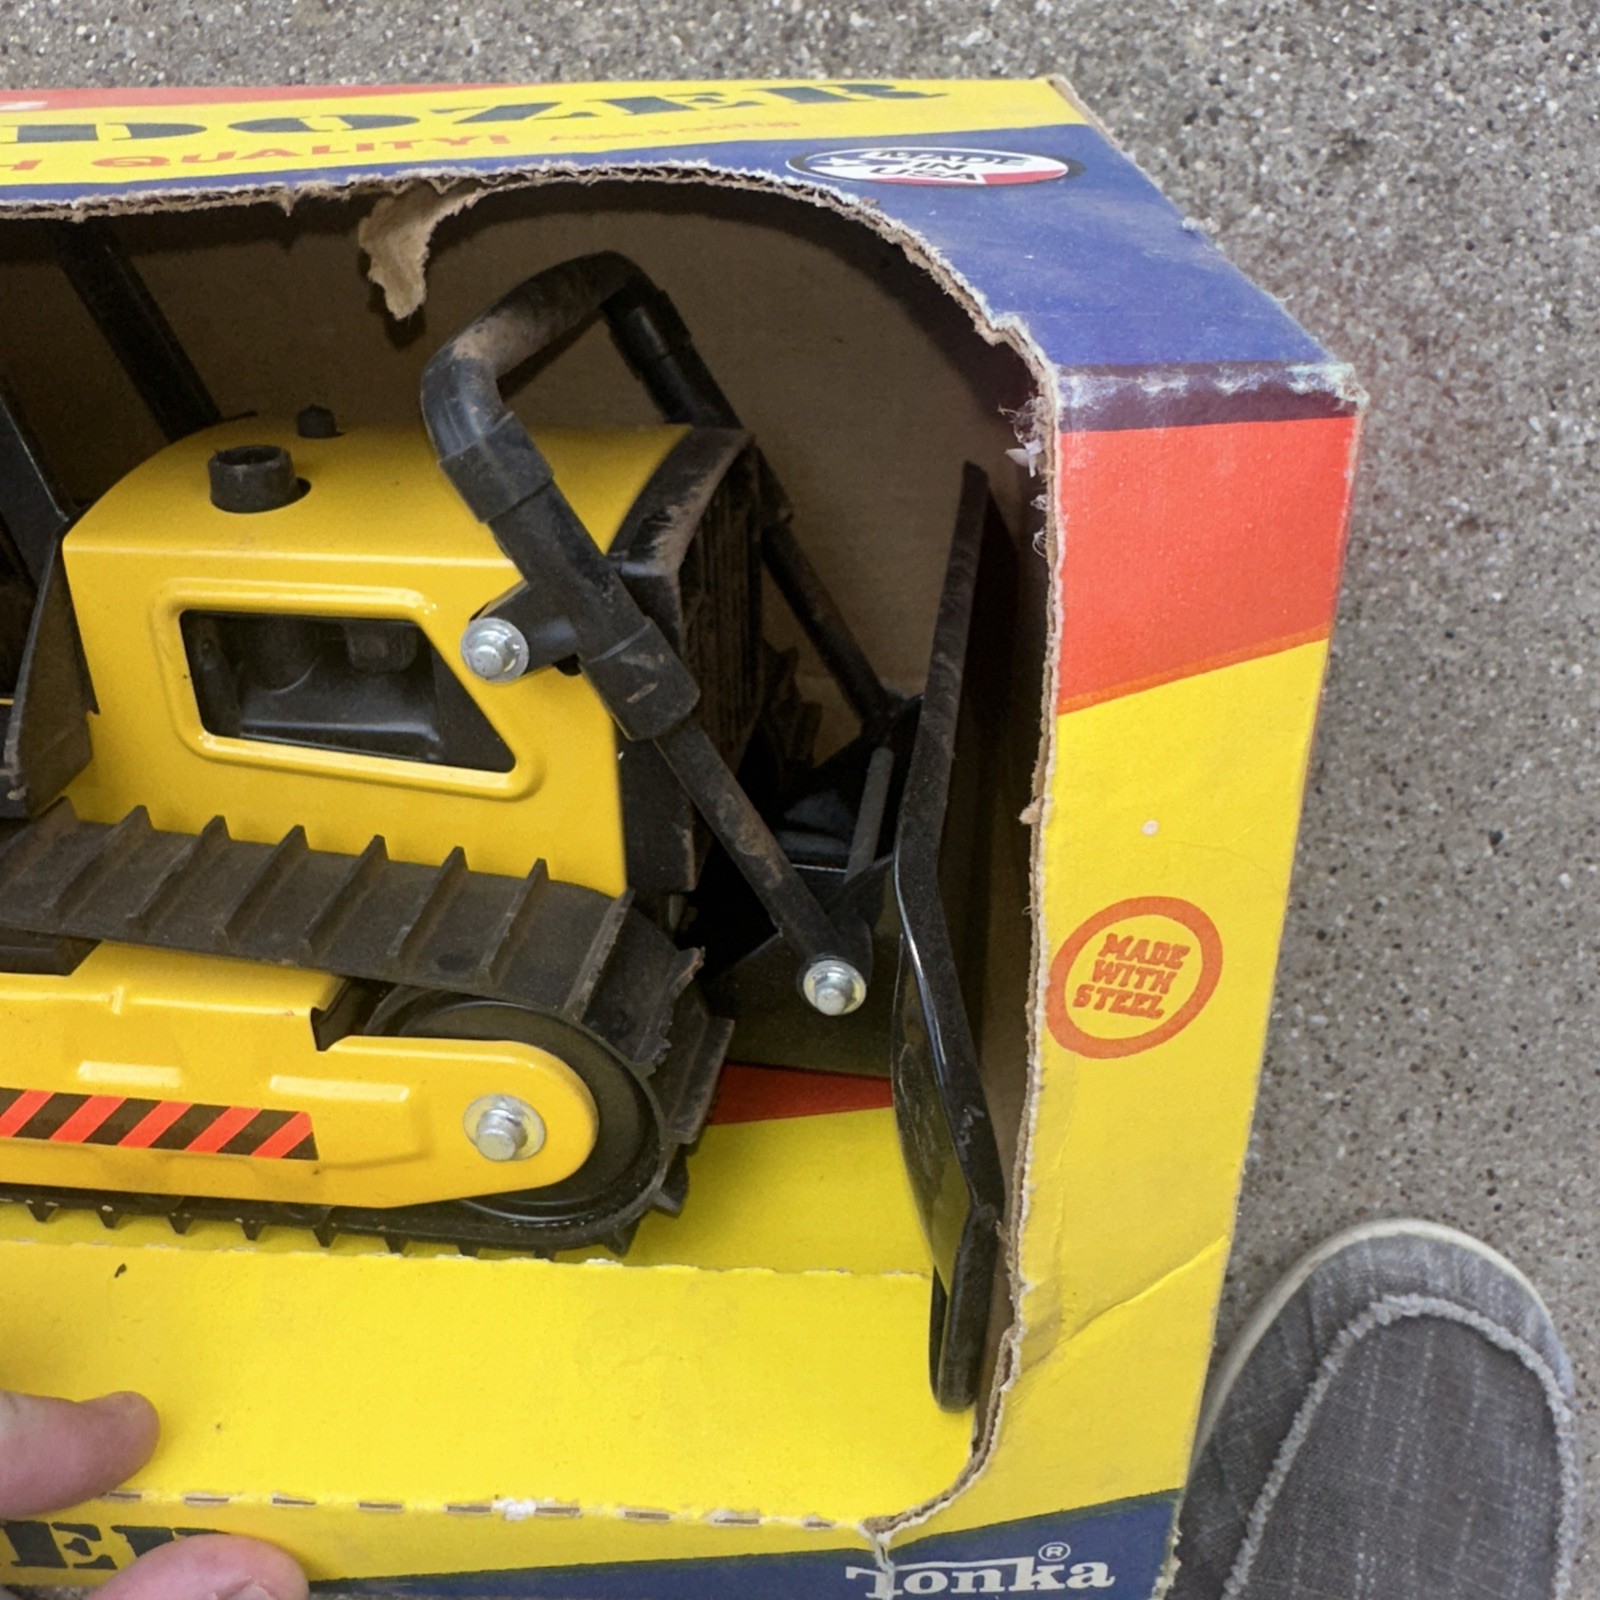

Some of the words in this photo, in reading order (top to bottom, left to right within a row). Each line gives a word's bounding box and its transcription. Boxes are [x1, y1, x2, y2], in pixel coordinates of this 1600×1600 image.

[91, 134, 510, 167] QUALITY!
[857, 150, 1032, 167] MADE
[912, 162, 969, 171] IN
[869, 166, 978, 181] USA
[1097, 933, 1190, 970] MADE
[1091, 960, 1177, 995] WITH
[1072, 984, 1165, 1020] STEEL
